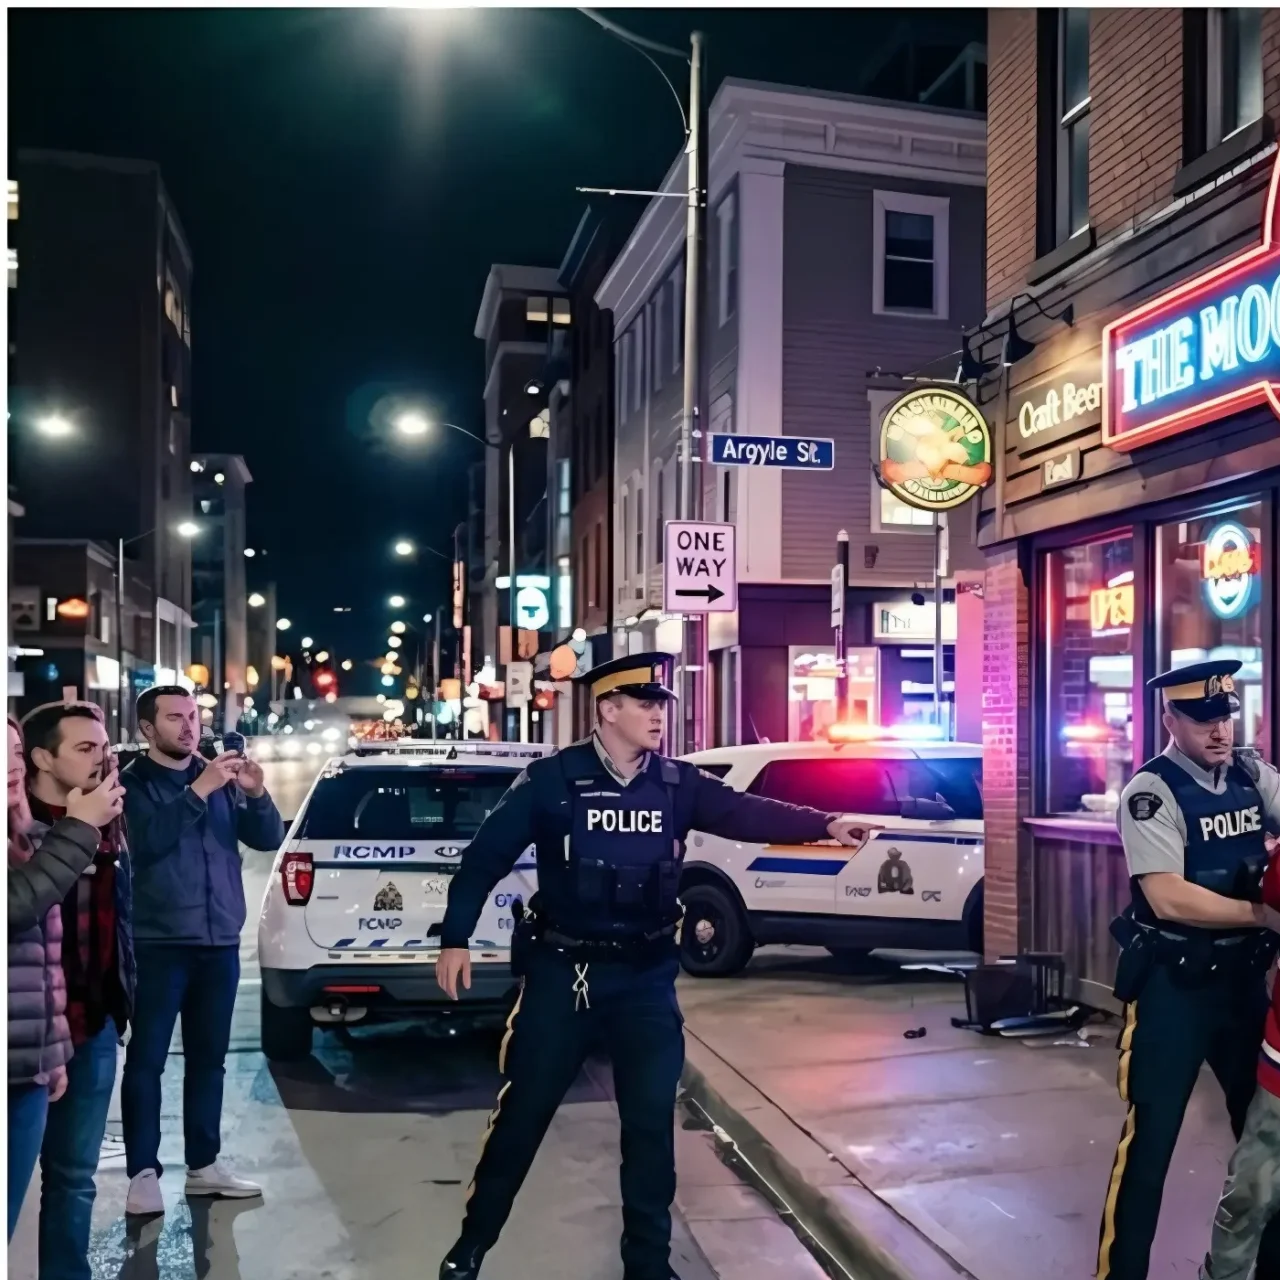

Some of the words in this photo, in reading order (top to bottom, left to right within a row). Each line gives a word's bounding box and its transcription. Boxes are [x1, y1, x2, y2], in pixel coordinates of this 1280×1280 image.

[1115, 316, 1195, 413] THE
[722, 438, 788, 466] Argyle
[676, 530, 726, 551] ONE
[676, 557, 727, 577] WAY
[586, 808, 663, 833] POLICE
[333, 844, 416, 860] RCMP
